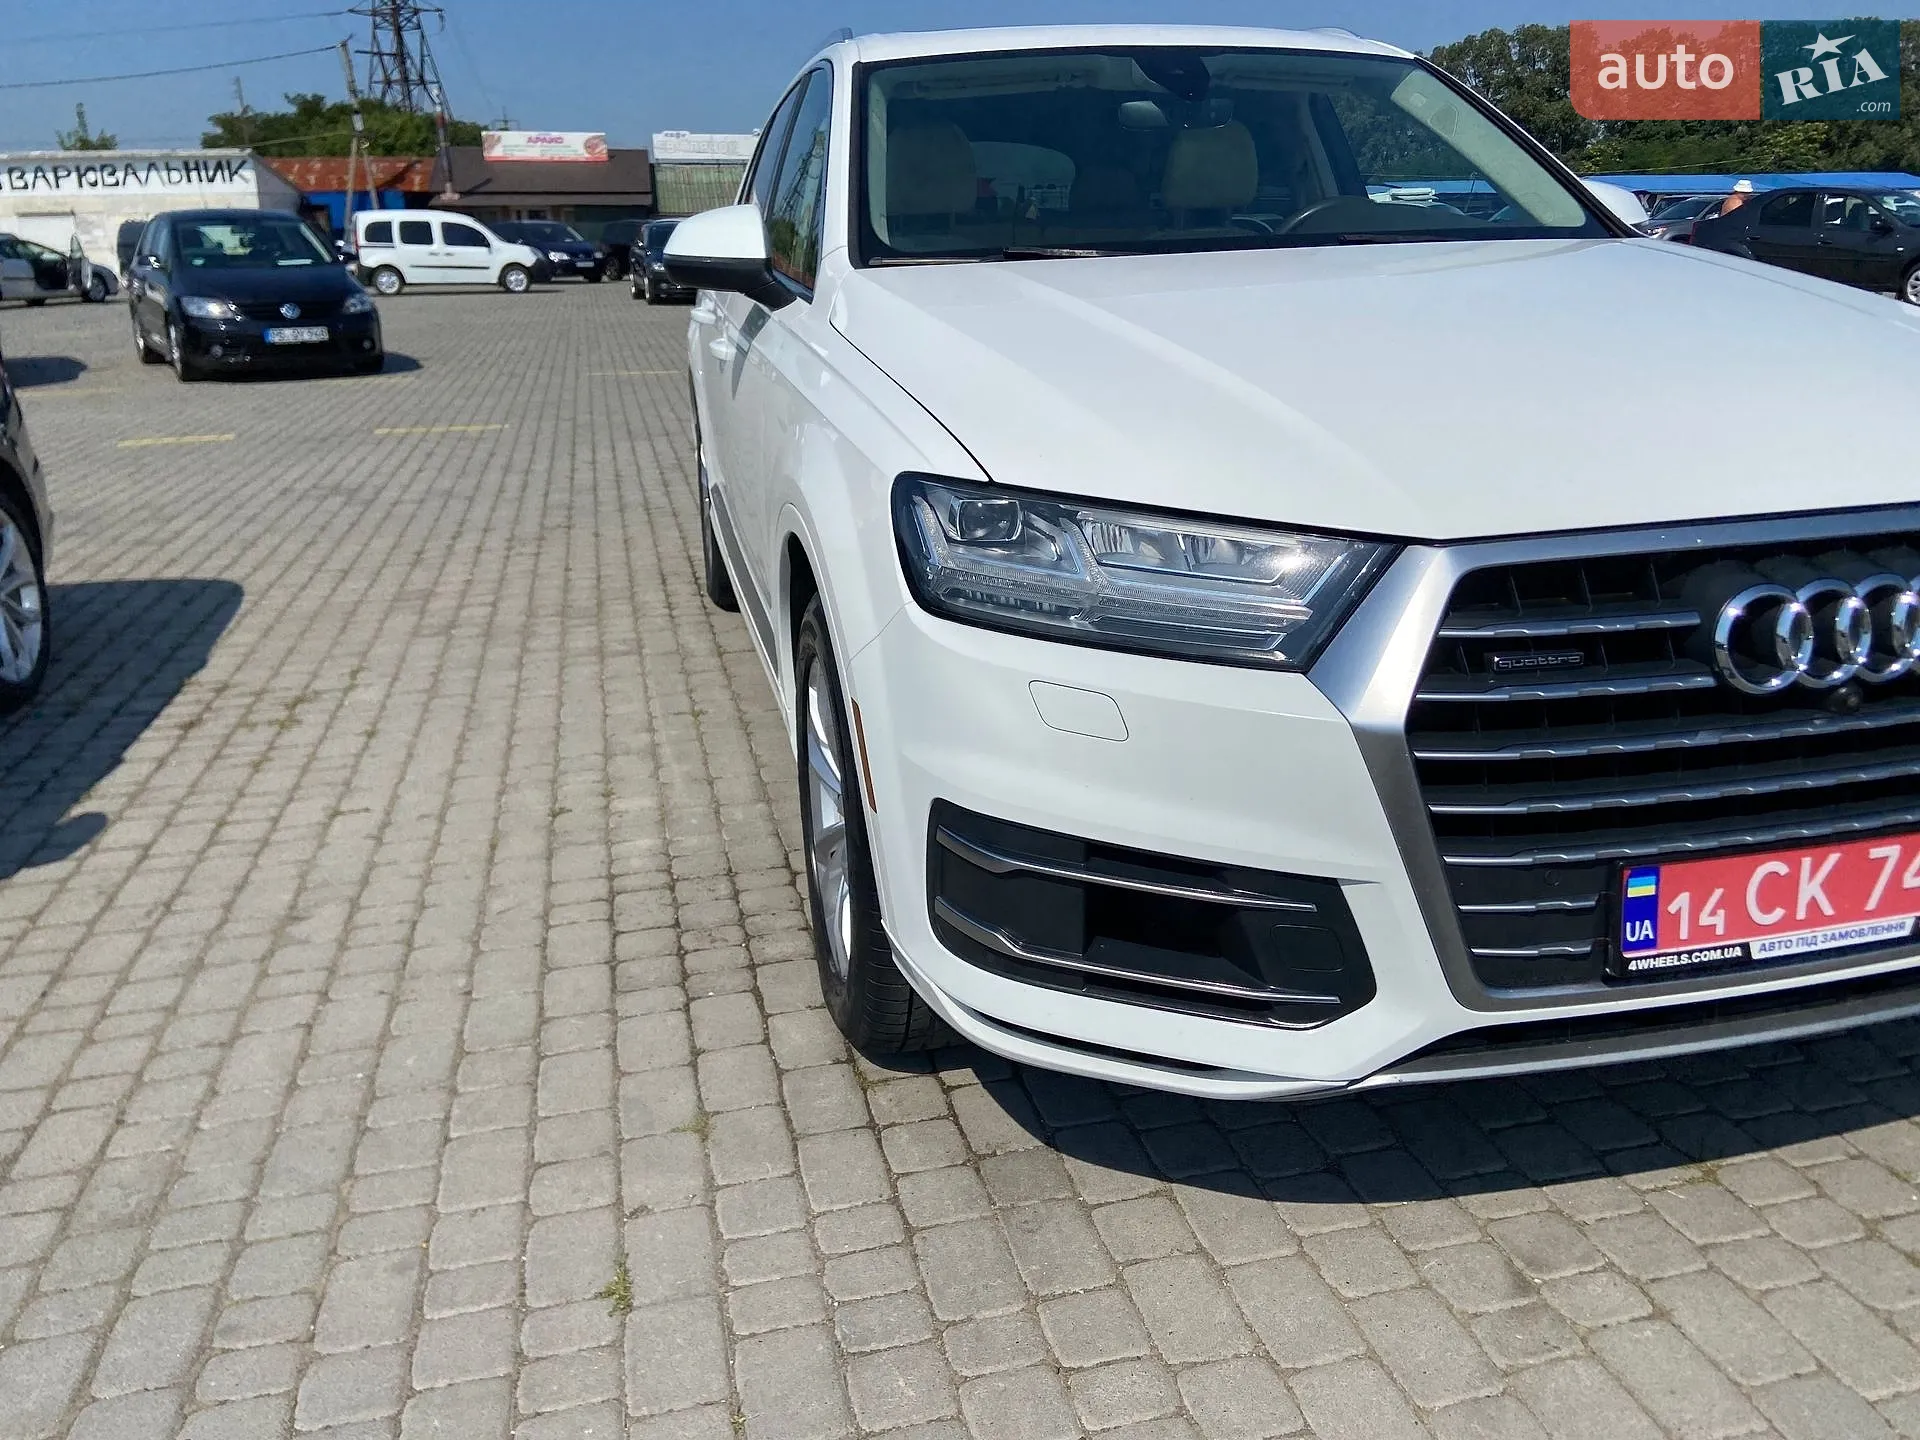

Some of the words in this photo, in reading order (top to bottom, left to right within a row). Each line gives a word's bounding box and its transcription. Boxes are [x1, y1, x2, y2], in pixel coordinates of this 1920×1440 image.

[1499, 656, 1580, 669] quattro
[1667, 887, 1726, 940] 14
[1746, 852, 1842, 926] CK
[1625, 919, 1655, 942] UA
[1759, 939, 1793, 953] АВТО
[1795, 935, 1818, 950] ПІД
[1820, 920, 1906, 944] ЗАМОВЛЕННЯ
[1628, 946, 1742, 971] 4WHEELS.COM.UA
